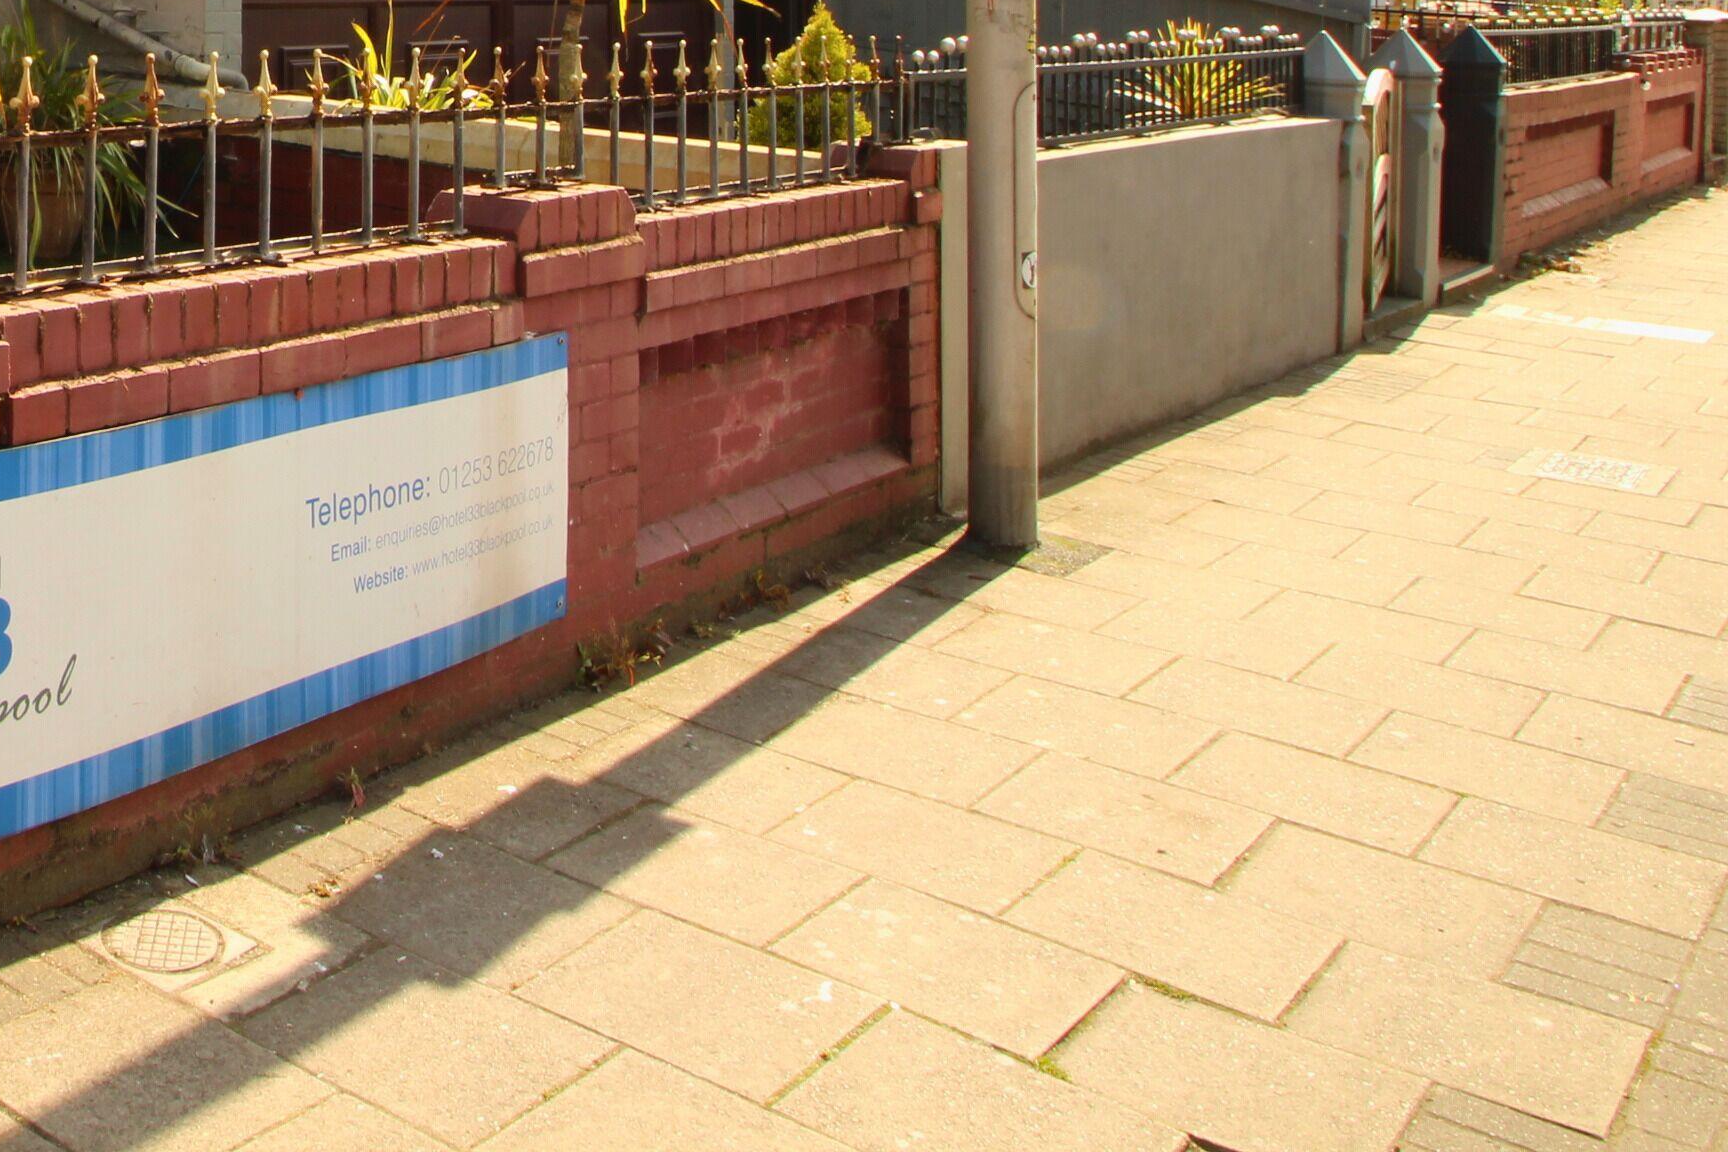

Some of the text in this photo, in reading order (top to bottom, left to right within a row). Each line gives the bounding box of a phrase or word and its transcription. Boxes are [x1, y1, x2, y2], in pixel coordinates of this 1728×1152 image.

[305, 435, 555, 529] Telephone: 01253 622678
[331, 535, 371, 563] Email:
[353, 564, 409, 594] Website:
